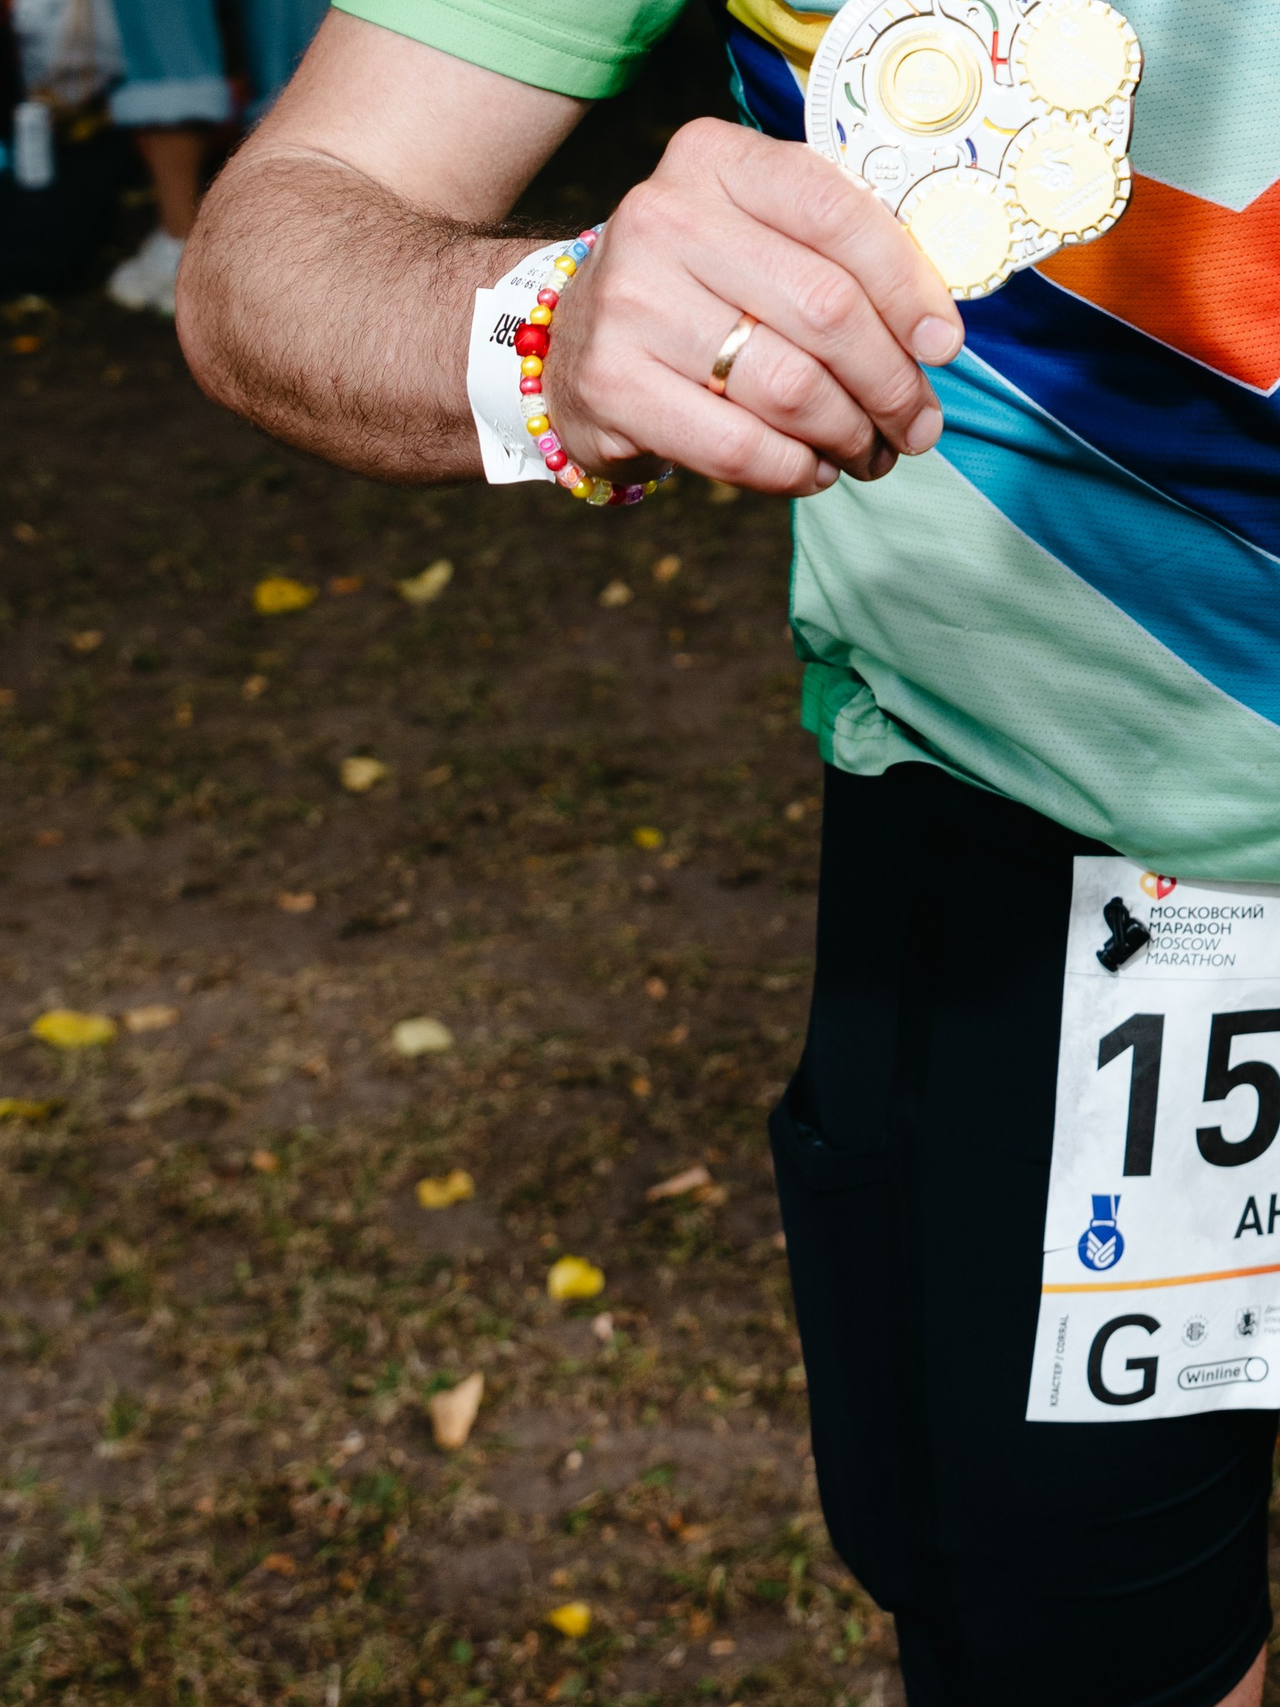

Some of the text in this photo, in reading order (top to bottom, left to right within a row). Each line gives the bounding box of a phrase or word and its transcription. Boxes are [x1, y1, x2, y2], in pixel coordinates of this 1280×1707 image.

[1149, 904, 1265, 920] МОСКОВСКИЙ
[1149, 921, 1232, 935] МАРАФОН
[1146, 937, 1222, 951] MOSCOW
[1145, 952, 1237, 967] MARATHON
[1087, 1313, 1162, 1406] G
[1186, 1367, 1241, 1383] Winline
